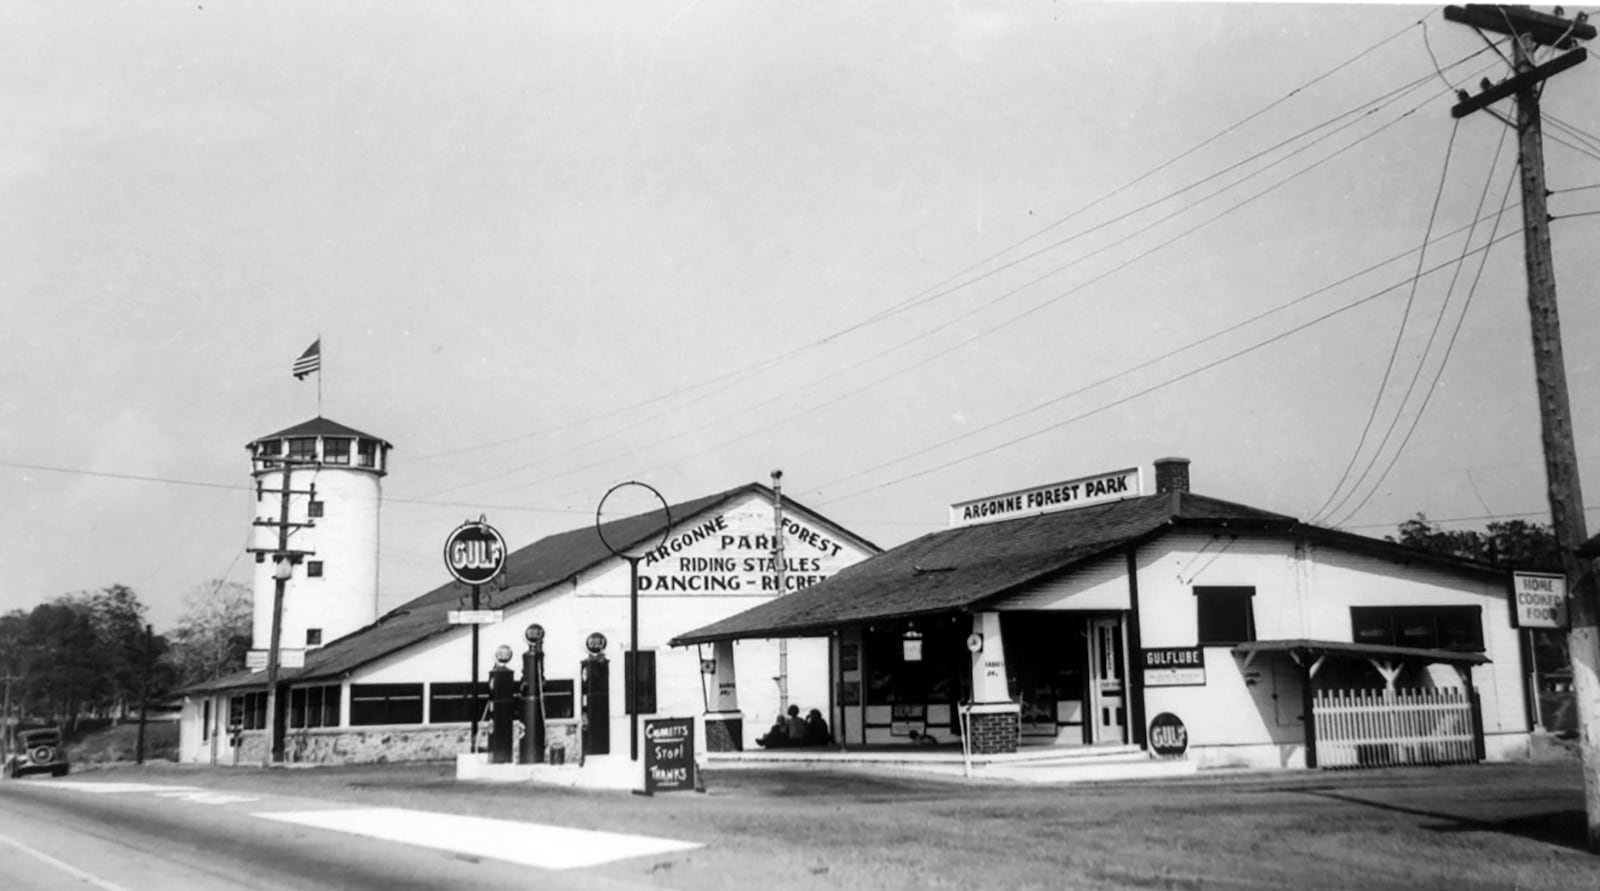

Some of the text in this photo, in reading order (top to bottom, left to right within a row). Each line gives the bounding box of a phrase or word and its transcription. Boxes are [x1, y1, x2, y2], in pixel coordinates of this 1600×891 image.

[963, 475, 1128, 520] ARGONNE FOREST PARK
[645, 515, 843, 567] ARGONNE FOREST
[451, 540, 500, 569] GULF
[679, 557, 736, 572] RIDING
[638, 575, 741, 591] DANCING
[1523, 578, 1554, 592] HOME
[1519, 593, 1562, 607] COOKED
[1526, 607, 1558, 620] FOOD
[1146, 651, 1199, 664] GULFLUBE
[1152, 726, 1185, 747] GULF
[649, 764, 687, 781] THANKS
